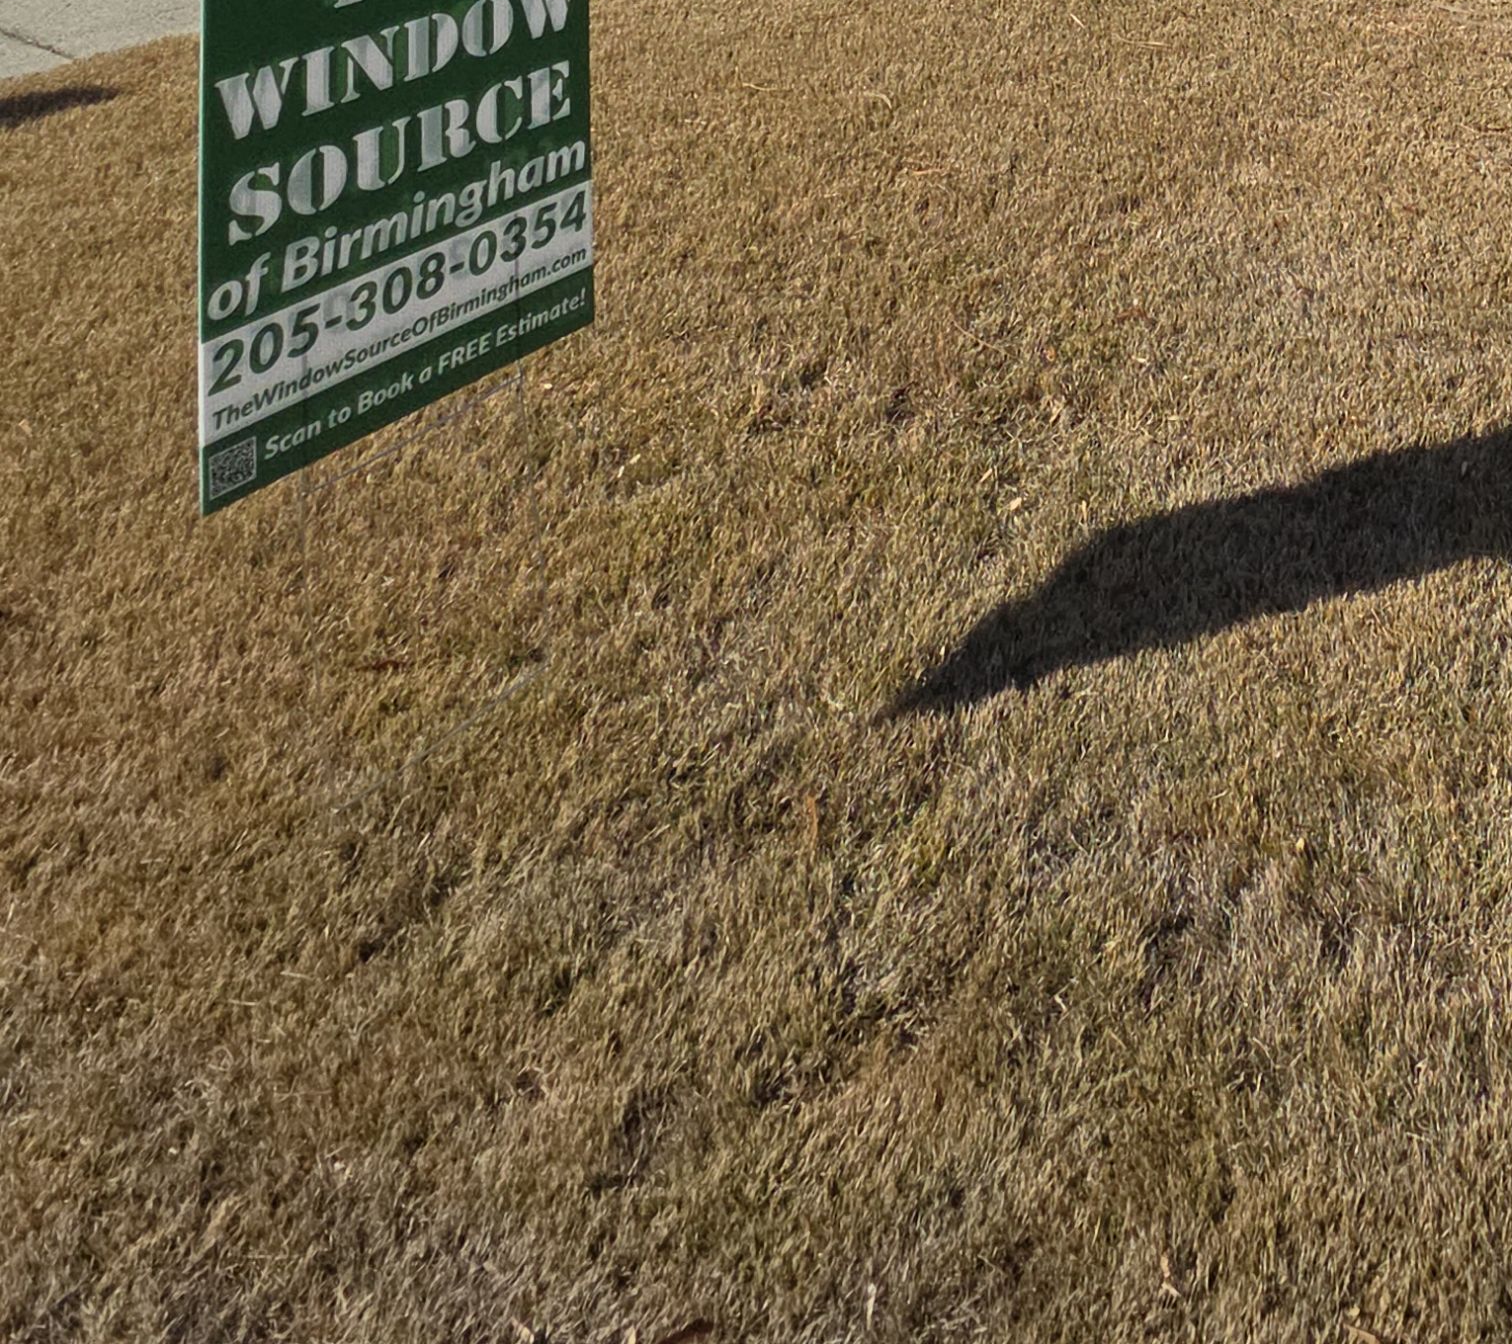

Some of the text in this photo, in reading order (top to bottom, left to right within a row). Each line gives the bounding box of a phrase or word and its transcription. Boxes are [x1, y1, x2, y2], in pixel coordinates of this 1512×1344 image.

[207, 140, 586, 321] of Birmingham
[227, 60, 571, 245] SOURCE
[208, 190, 587, 397] 205-308-0354
[212, 249, 587, 432] TheWindowSourceOfBirmingham.com
[264, 287, 587, 460] Scan to Book a FREE Estimate!
